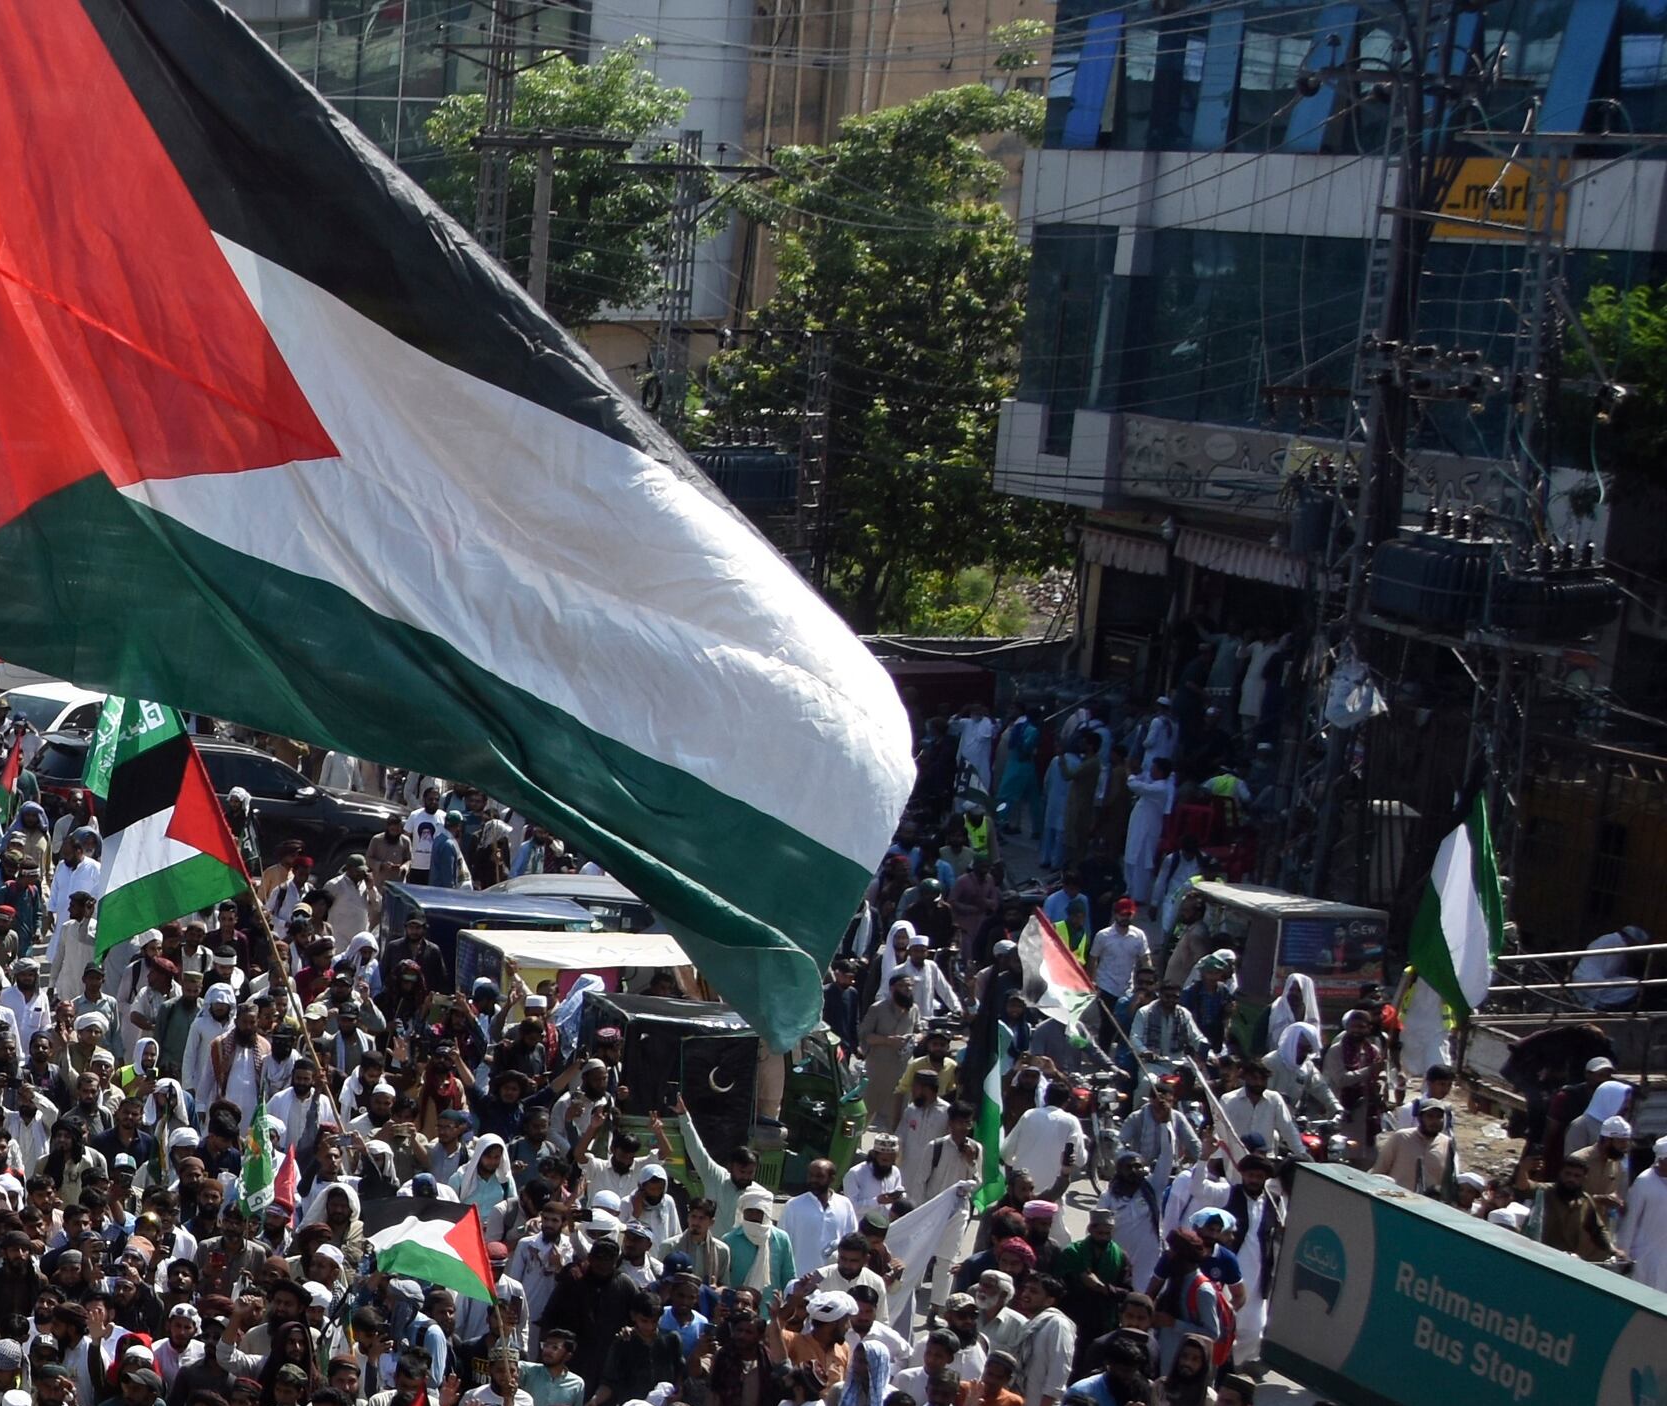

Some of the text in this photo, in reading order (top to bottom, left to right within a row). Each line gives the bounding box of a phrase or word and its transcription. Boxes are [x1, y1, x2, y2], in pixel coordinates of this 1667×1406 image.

[1395, 1260, 1575, 1367] Rehmanabad
[1413, 1314, 1533, 1402] Bus Stop
